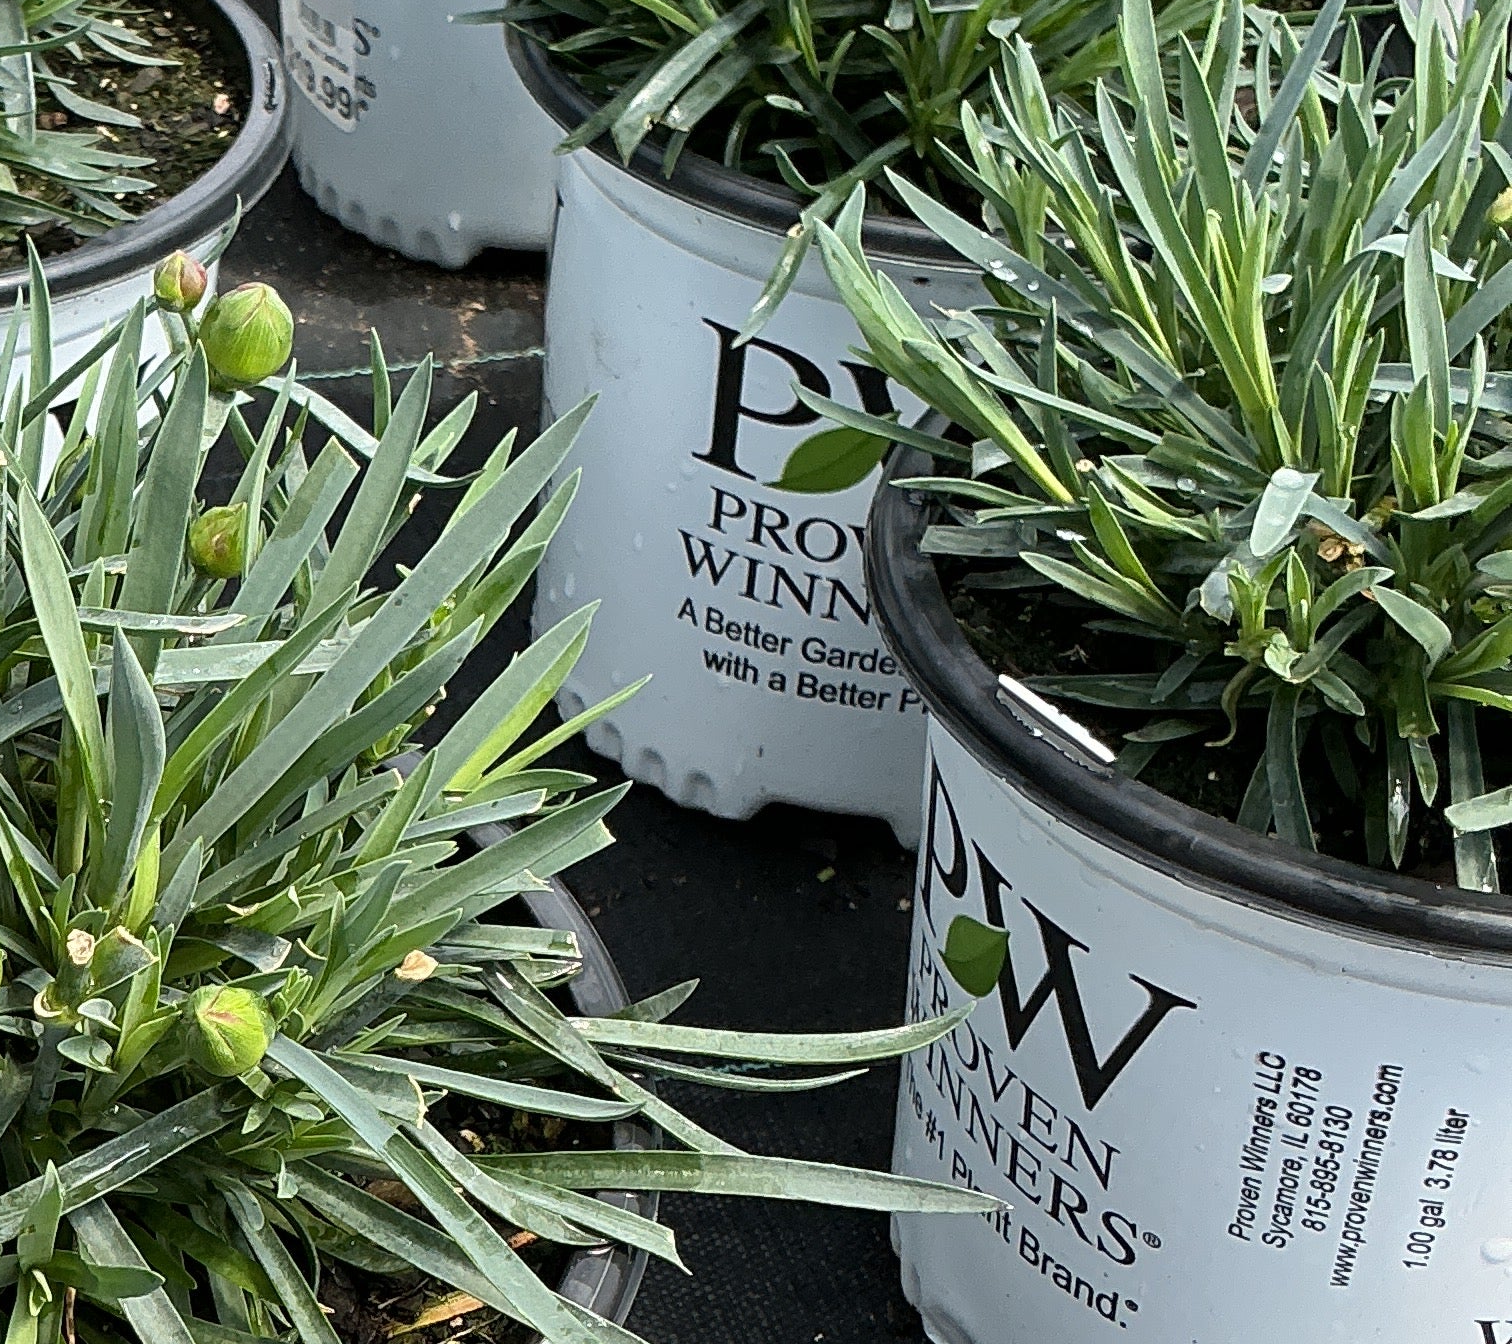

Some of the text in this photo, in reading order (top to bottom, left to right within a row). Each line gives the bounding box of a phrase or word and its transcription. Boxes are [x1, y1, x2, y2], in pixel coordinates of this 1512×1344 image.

[676, 596, 699, 627] A
[704, 606, 793, 656] Better
[702, 649, 759, 686] with
[767, 671, 787, 693] a
[796, 672, 891, 711] Better
[1227, 1050, 1287, 1242] Proven Winners LLC
[1261, 1065, 1323, 1249] Sycamore, IL 60178
[1301, 1105, 1353, 1233] 815-895-8130
[1329, 1063, 1405, 1288] www.provenwinners.com
[1402, 1107, 1471, 1269] 1.00 gal 3.78 liter
